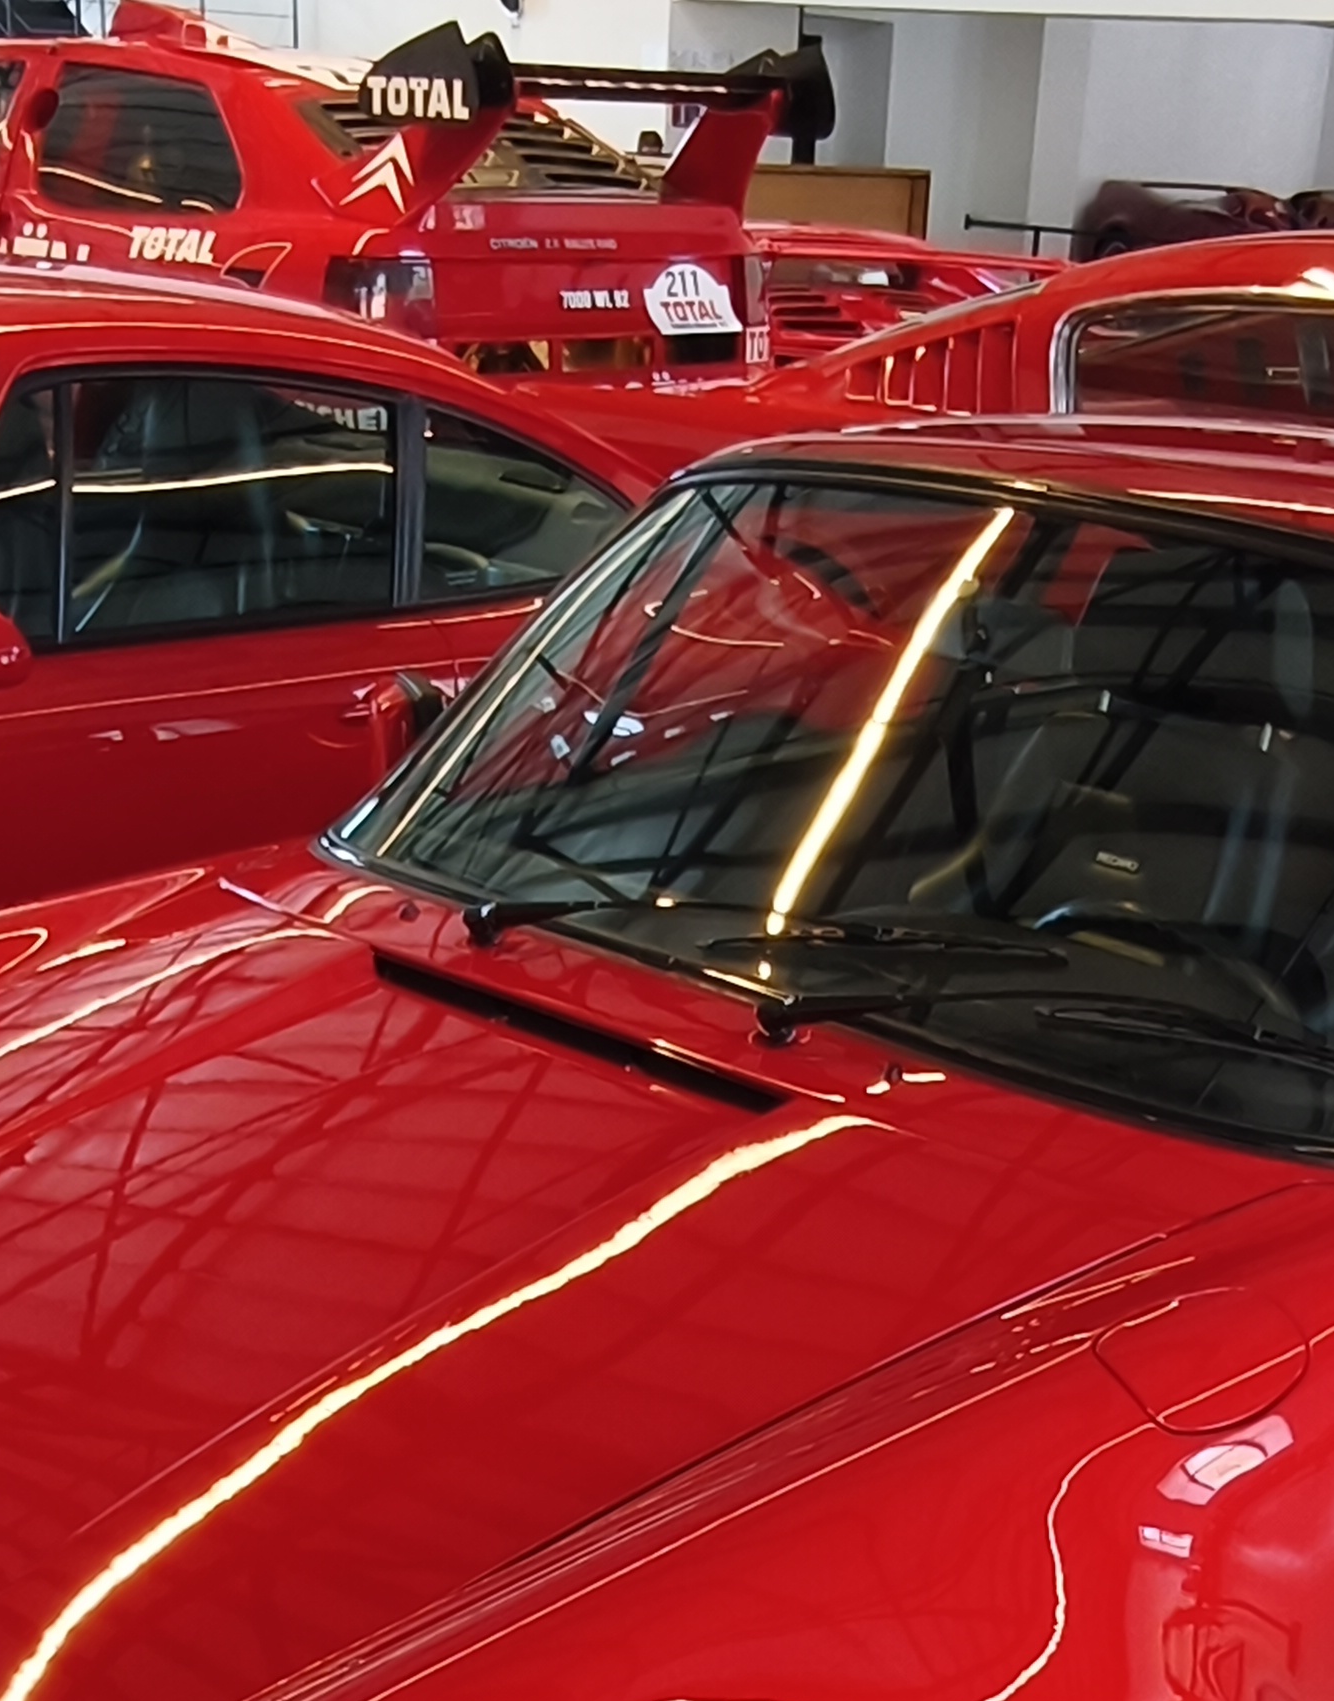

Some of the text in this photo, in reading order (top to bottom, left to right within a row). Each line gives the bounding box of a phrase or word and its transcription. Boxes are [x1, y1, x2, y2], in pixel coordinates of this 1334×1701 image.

[366, 75, 470, 120] TOTAL
[128, 225, 217, 264] TOTAL
[665, 269, 700, 298] 211
[659, 299, 723, 323] TOTAL
